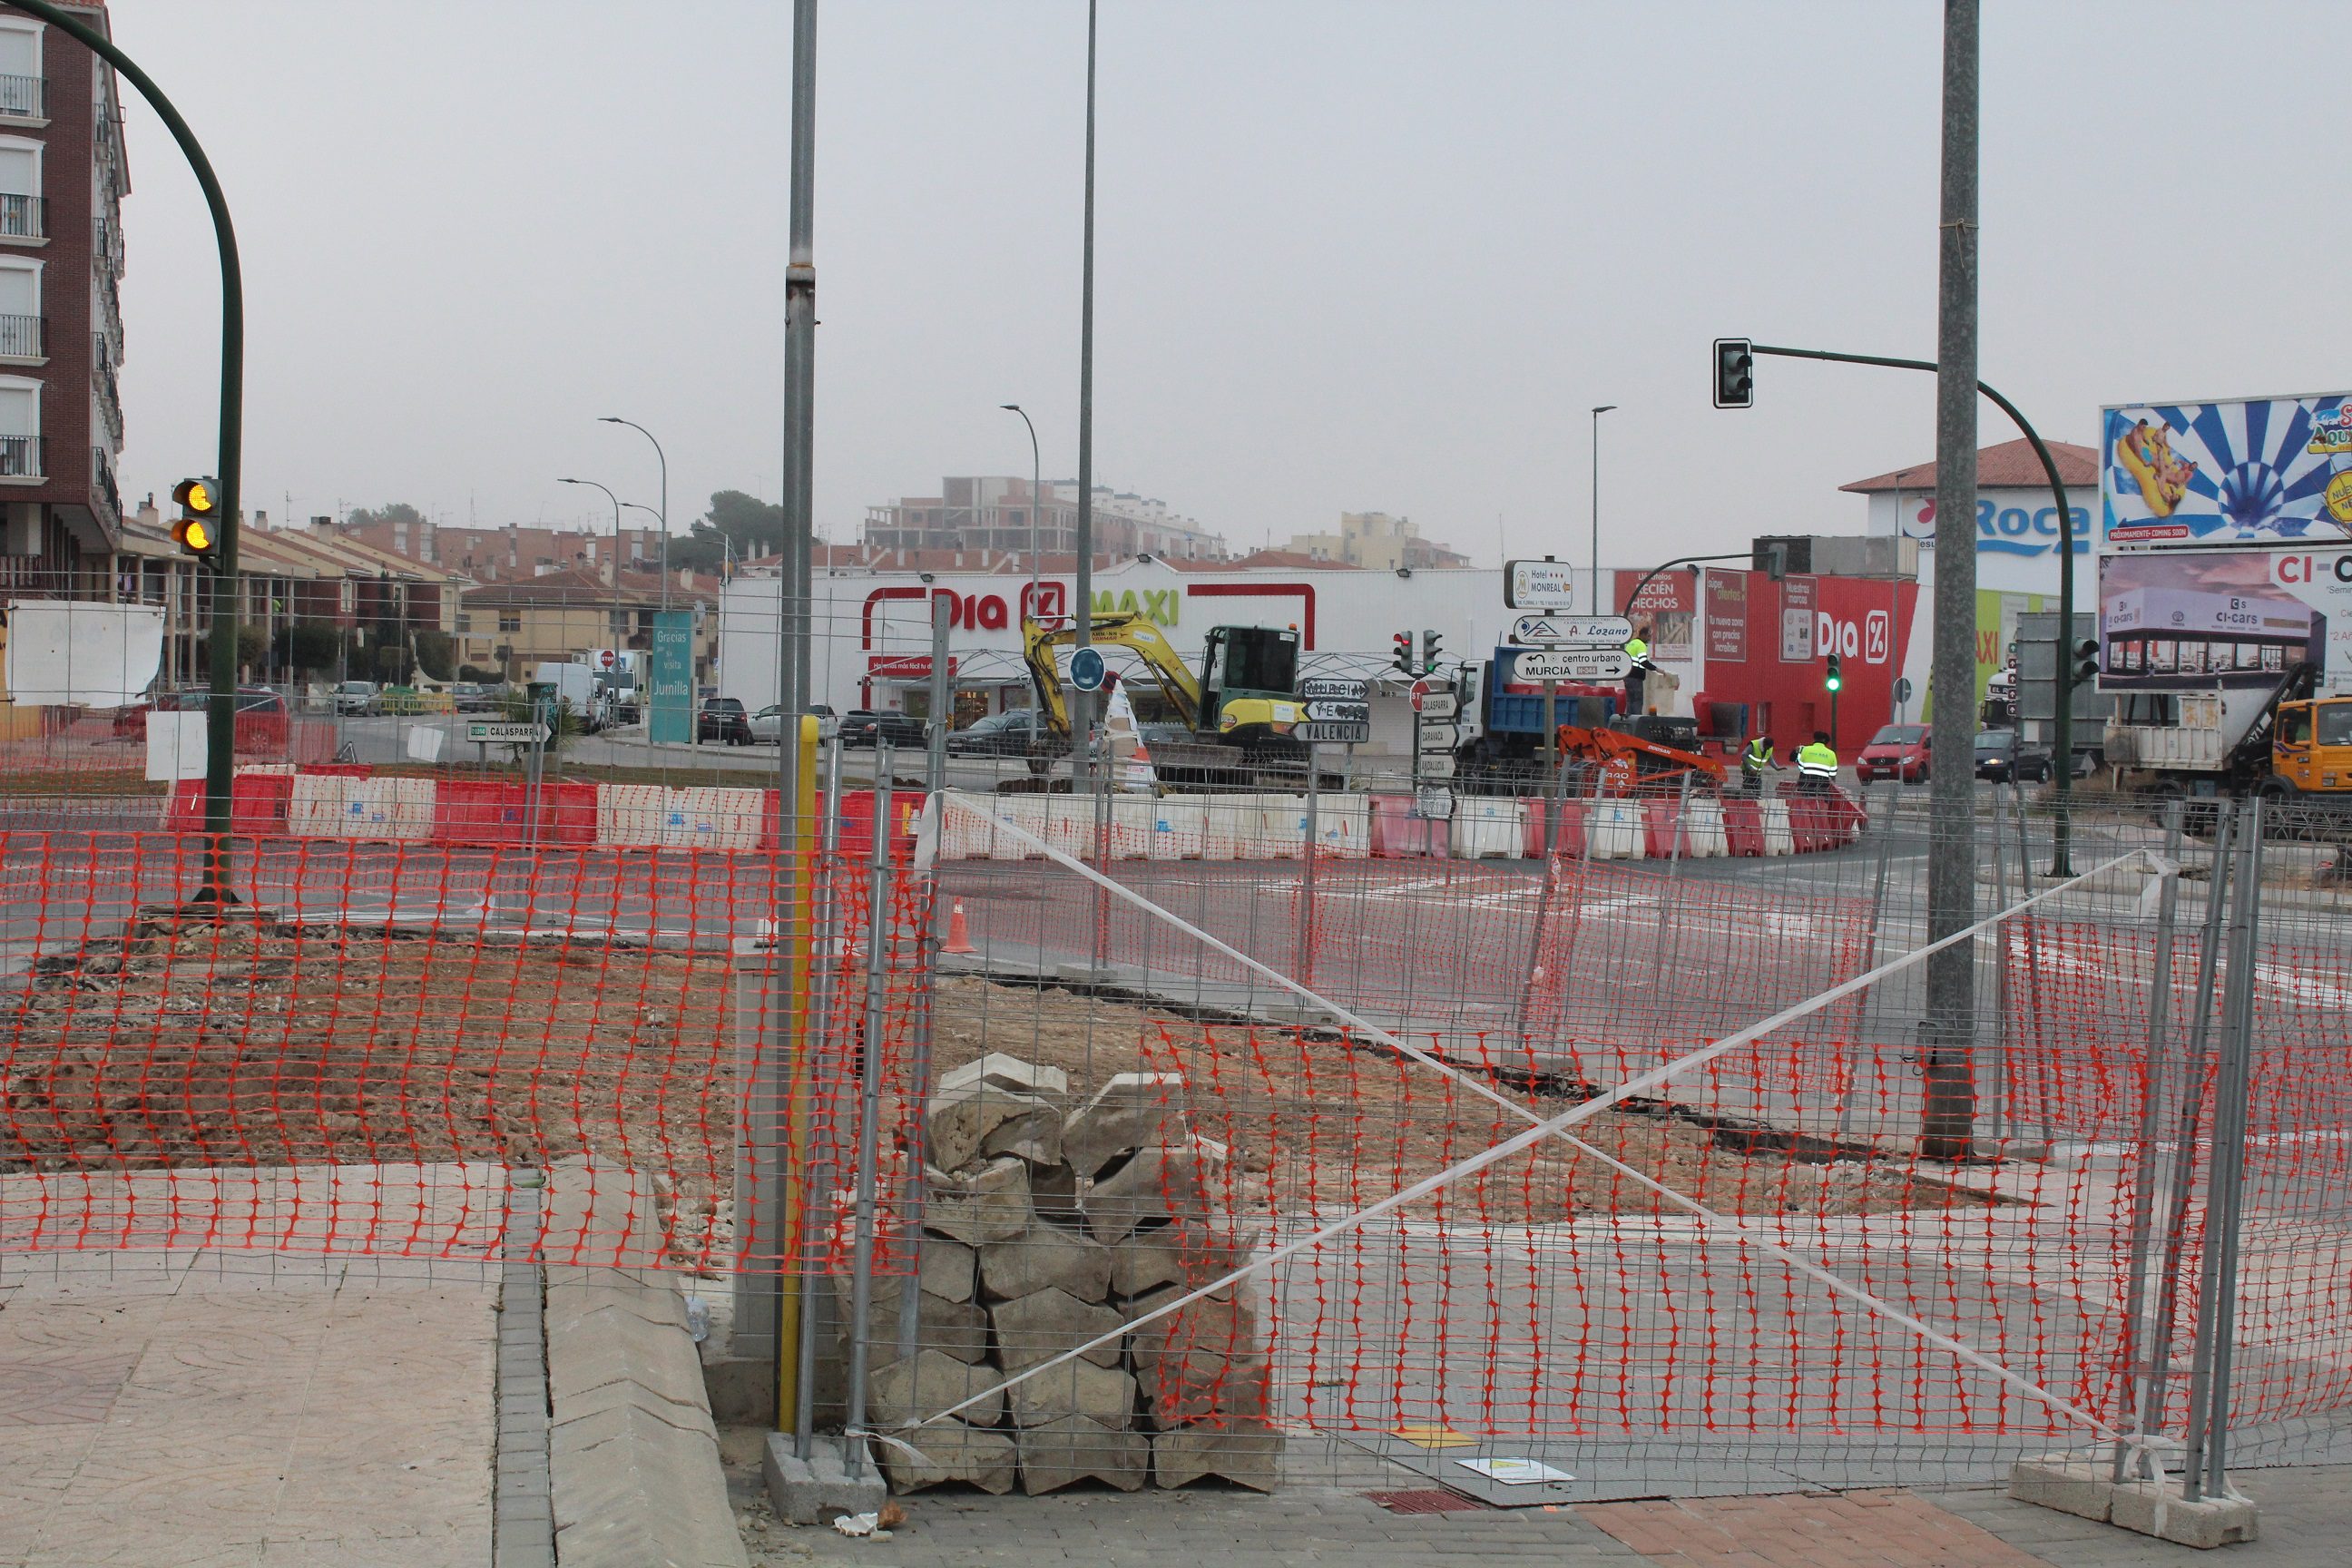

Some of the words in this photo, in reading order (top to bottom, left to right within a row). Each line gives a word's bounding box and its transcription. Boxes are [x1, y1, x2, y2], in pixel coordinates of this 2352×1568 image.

[2311, 426, 2352, 446] AQU
[1531, 570, 1548, 579] Hotel
[2278, 554, 2352, 583] CI-C
[1531, 583, 1561, 593] MONREAL
[1631, 597, 1679, 609] HECHOS
[1587, 625, 1629, 636] Lozano
[657, 631, 687, 643] Gracias
[1562, 654, 1591, 663] centro
[1592, 653, 1622, 662] urbano
[1526, 666, 1572, 676] MURCIA
[653, 681, 689, 696] Jumilla
[1423, 699, 1449, 711] CALASPARRA
[1307, 724, 1361, 740] VALENCIA
[1422, 730, 1444, 741] CARAVACA
